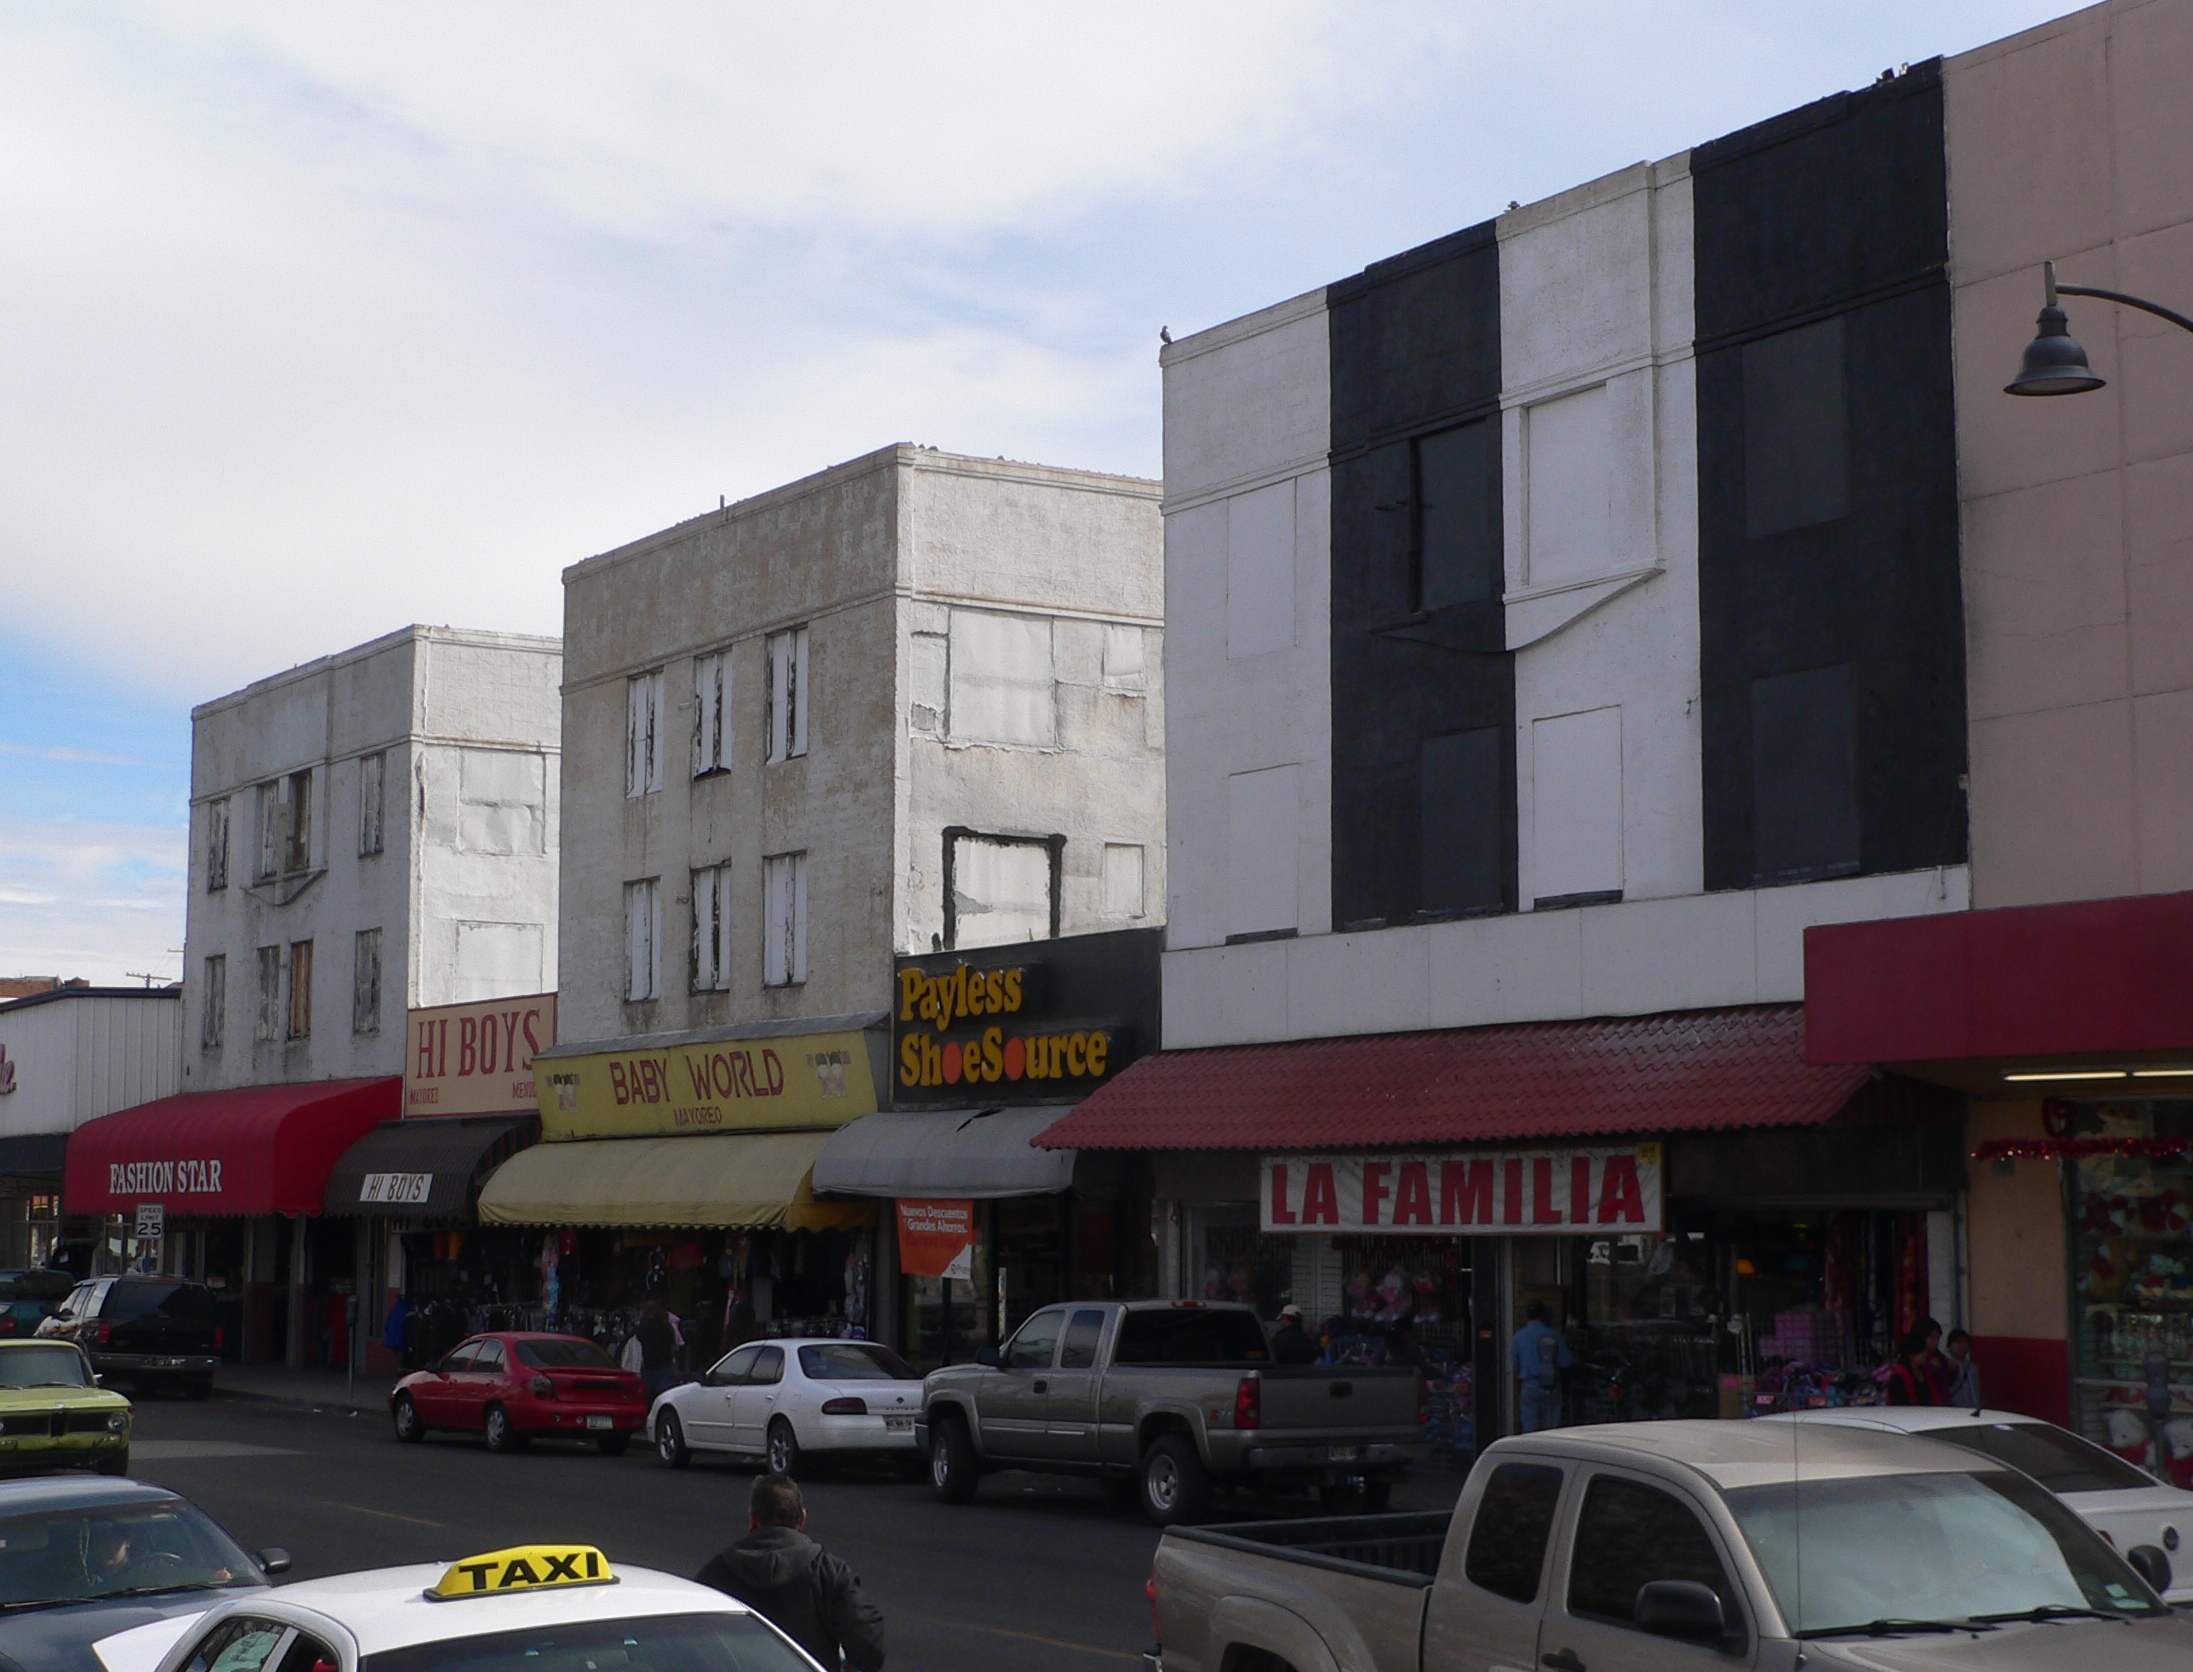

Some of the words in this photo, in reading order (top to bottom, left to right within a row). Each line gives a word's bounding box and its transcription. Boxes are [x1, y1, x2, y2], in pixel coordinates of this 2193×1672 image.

[899, 964, 1023, 1032] Payless
[416, 1019, 448, 1078] HI
[458, 1009, 540, 1077] BOYS
[899, 1026, 1108, 1087] ShoeSource
[609, 1058, 671, 1105] BABY
[686, 1048, 785, 1100] WORLD
[674, 1106, 723, 1127] MAYOREO
[109, 1161, 175, 1194] FASHION
[177, 1159, 223, 1193] STAR
[366, 1175, 384, 1200] HI
[387, 1175, 425, 1201] BOYS
[1271, 1162, 1340, 1226] LA
[1361, 1154, 1647, 1226] FAMILIA
[138, 1222, 162, 1236] 25
[907, 1218, 936, 1231] Grandes
[458, 1551, 600, 1591] TAXI
